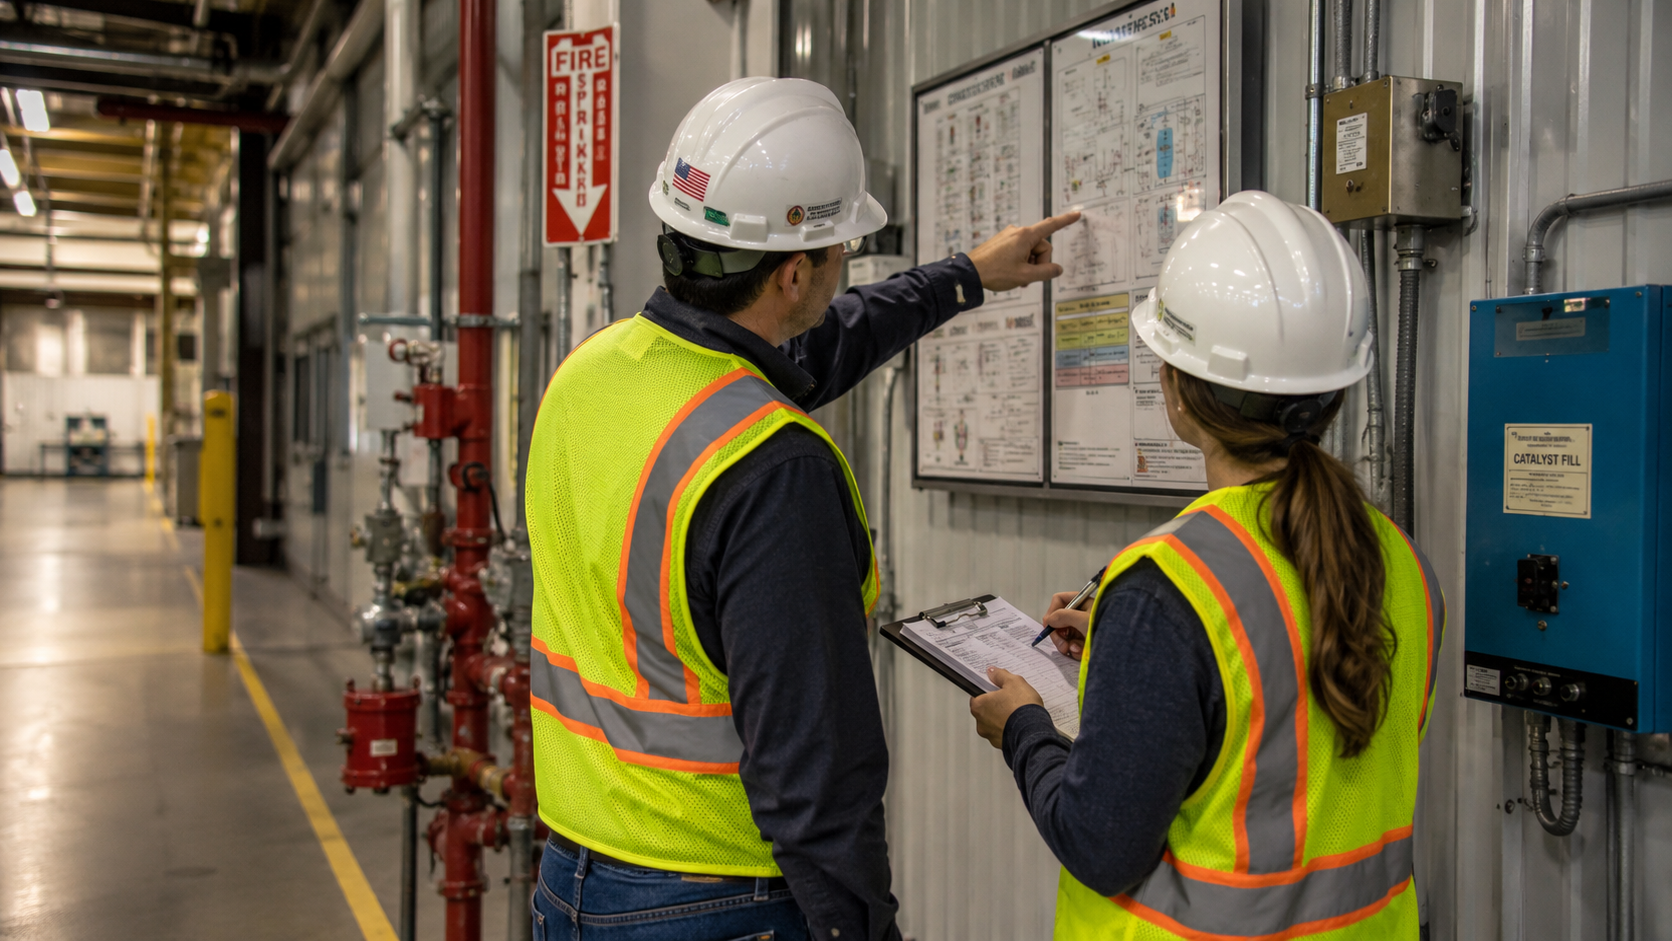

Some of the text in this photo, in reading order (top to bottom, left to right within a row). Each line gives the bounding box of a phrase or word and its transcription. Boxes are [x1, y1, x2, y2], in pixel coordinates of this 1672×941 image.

[555, 45, 606, 72] FIRE
[1513, 453, 1581, 467] CATALYST FILL
